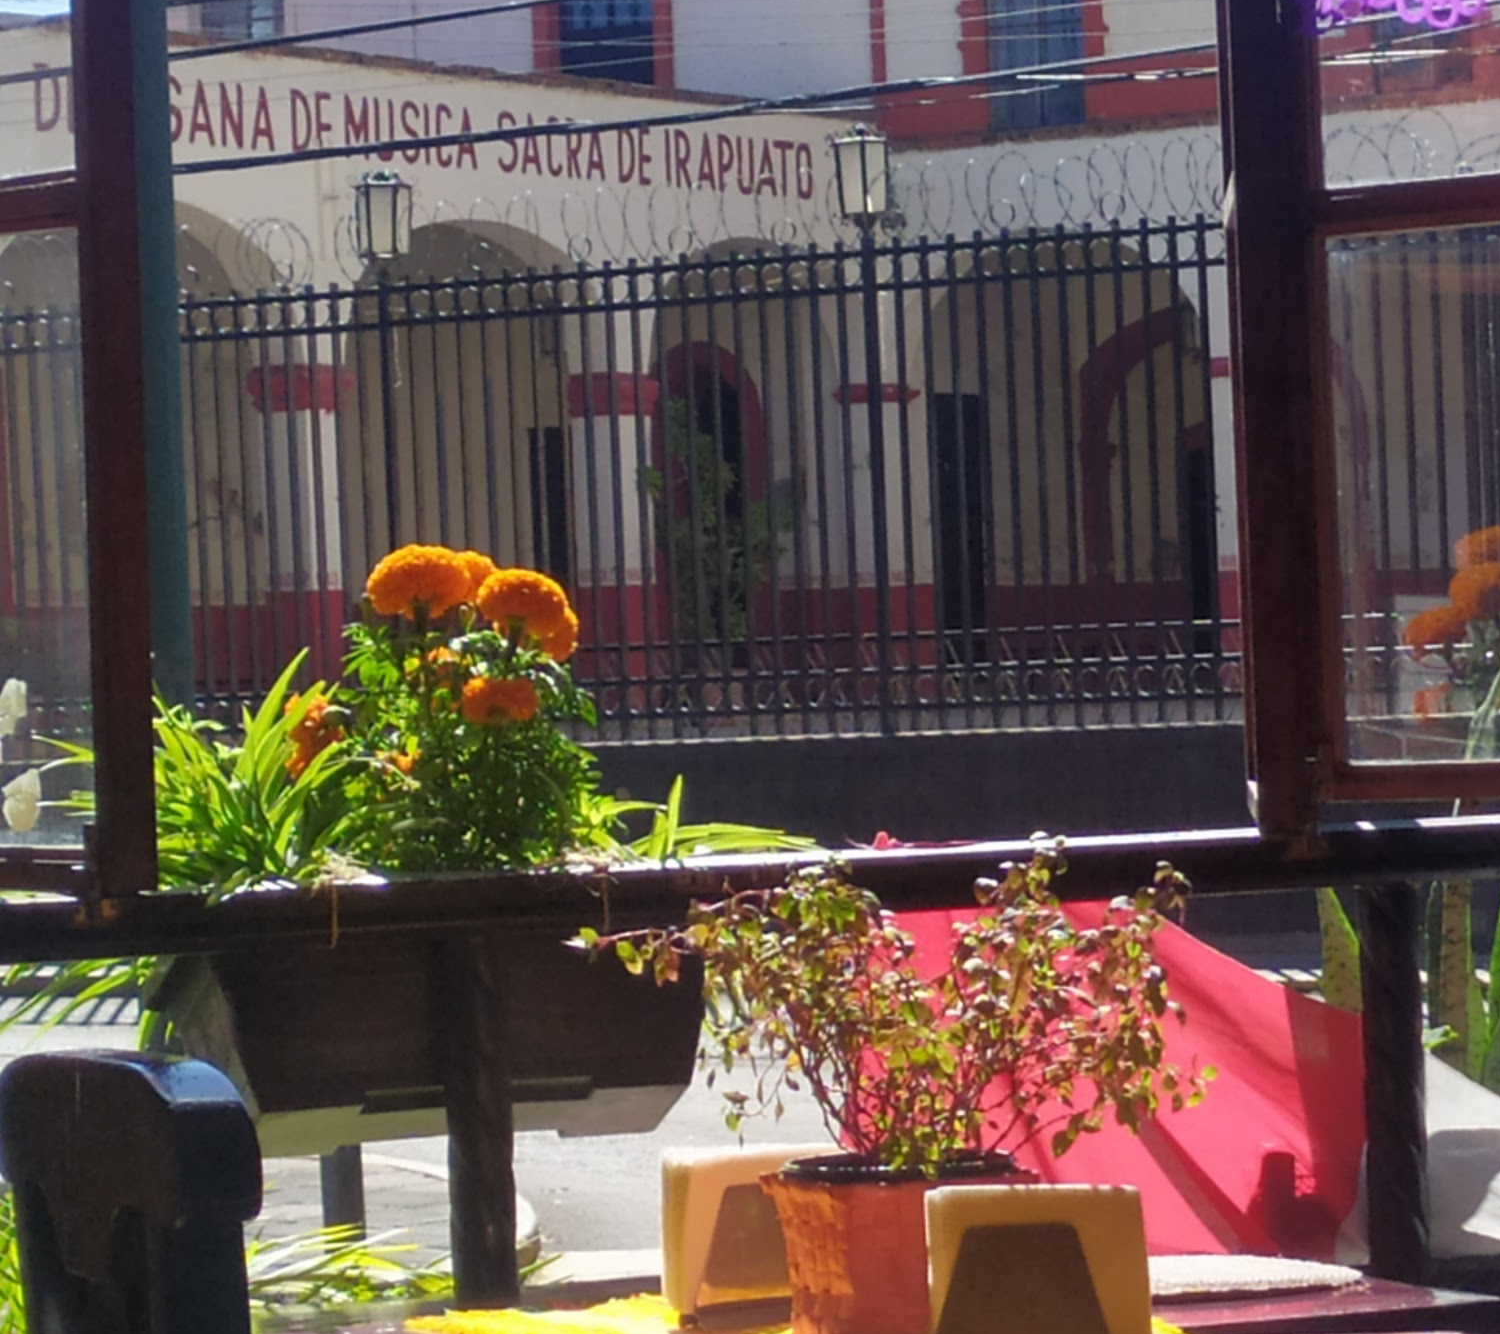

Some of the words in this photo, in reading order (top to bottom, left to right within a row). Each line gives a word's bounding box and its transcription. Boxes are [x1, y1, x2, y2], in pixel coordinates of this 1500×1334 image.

[343, 94, 478, 169] MUSICA
[497, 111, 606, 181] SACRA
[617, 126, 651, 186] DE
[663, 128, 813, 201] IRAPUATO
